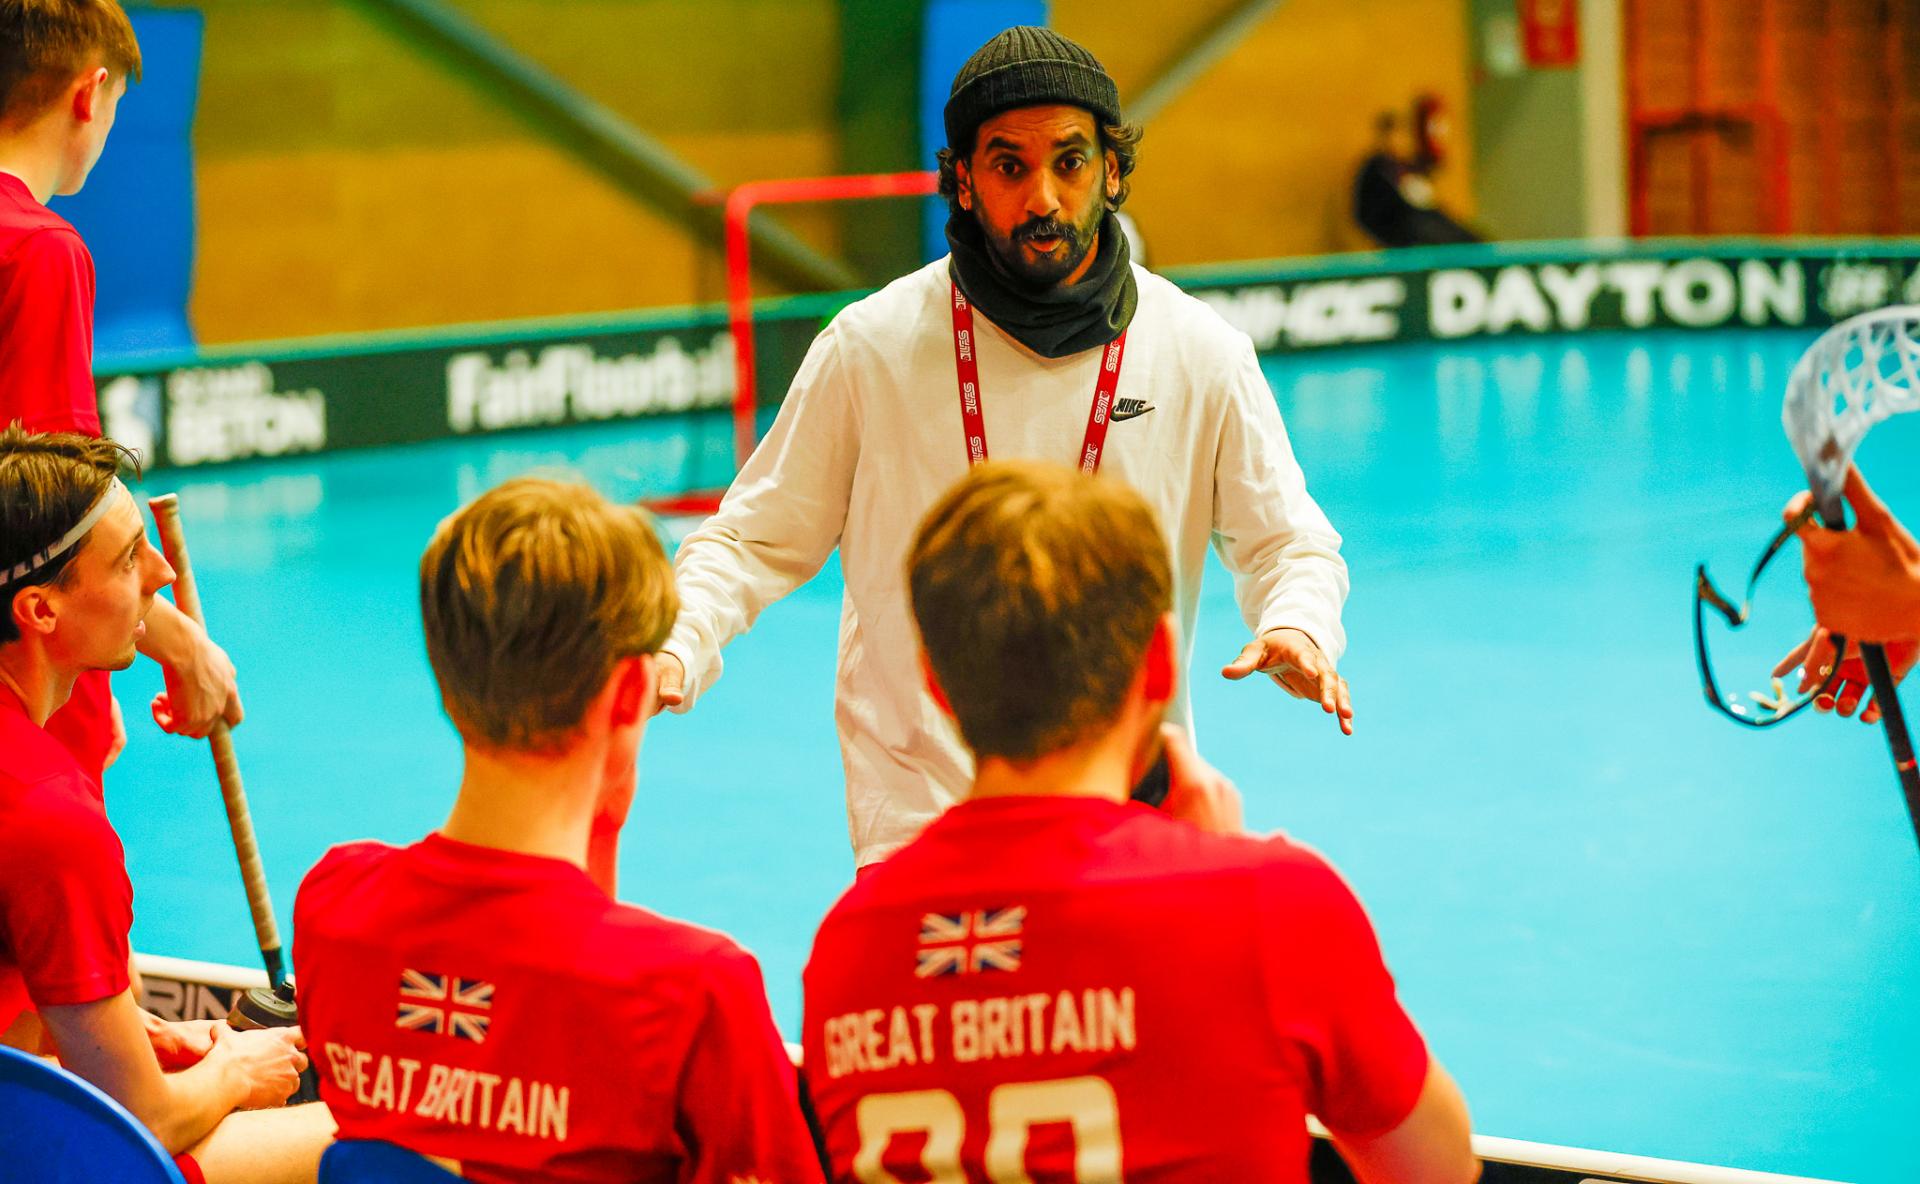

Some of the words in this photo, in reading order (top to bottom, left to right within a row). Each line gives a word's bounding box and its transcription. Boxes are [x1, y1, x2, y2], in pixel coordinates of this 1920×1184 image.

[1429, 260, 1804, 336] DAYTON
[447, 334, 736, 432] FairFloorbal
[1115, 398, 1146, 413] NIKE
[823, 1004, 938, 1078] GREAT
[951, 986, 1136, 1062] BRITAIN
[415, 1063, 569, 1142] BRITAIN
